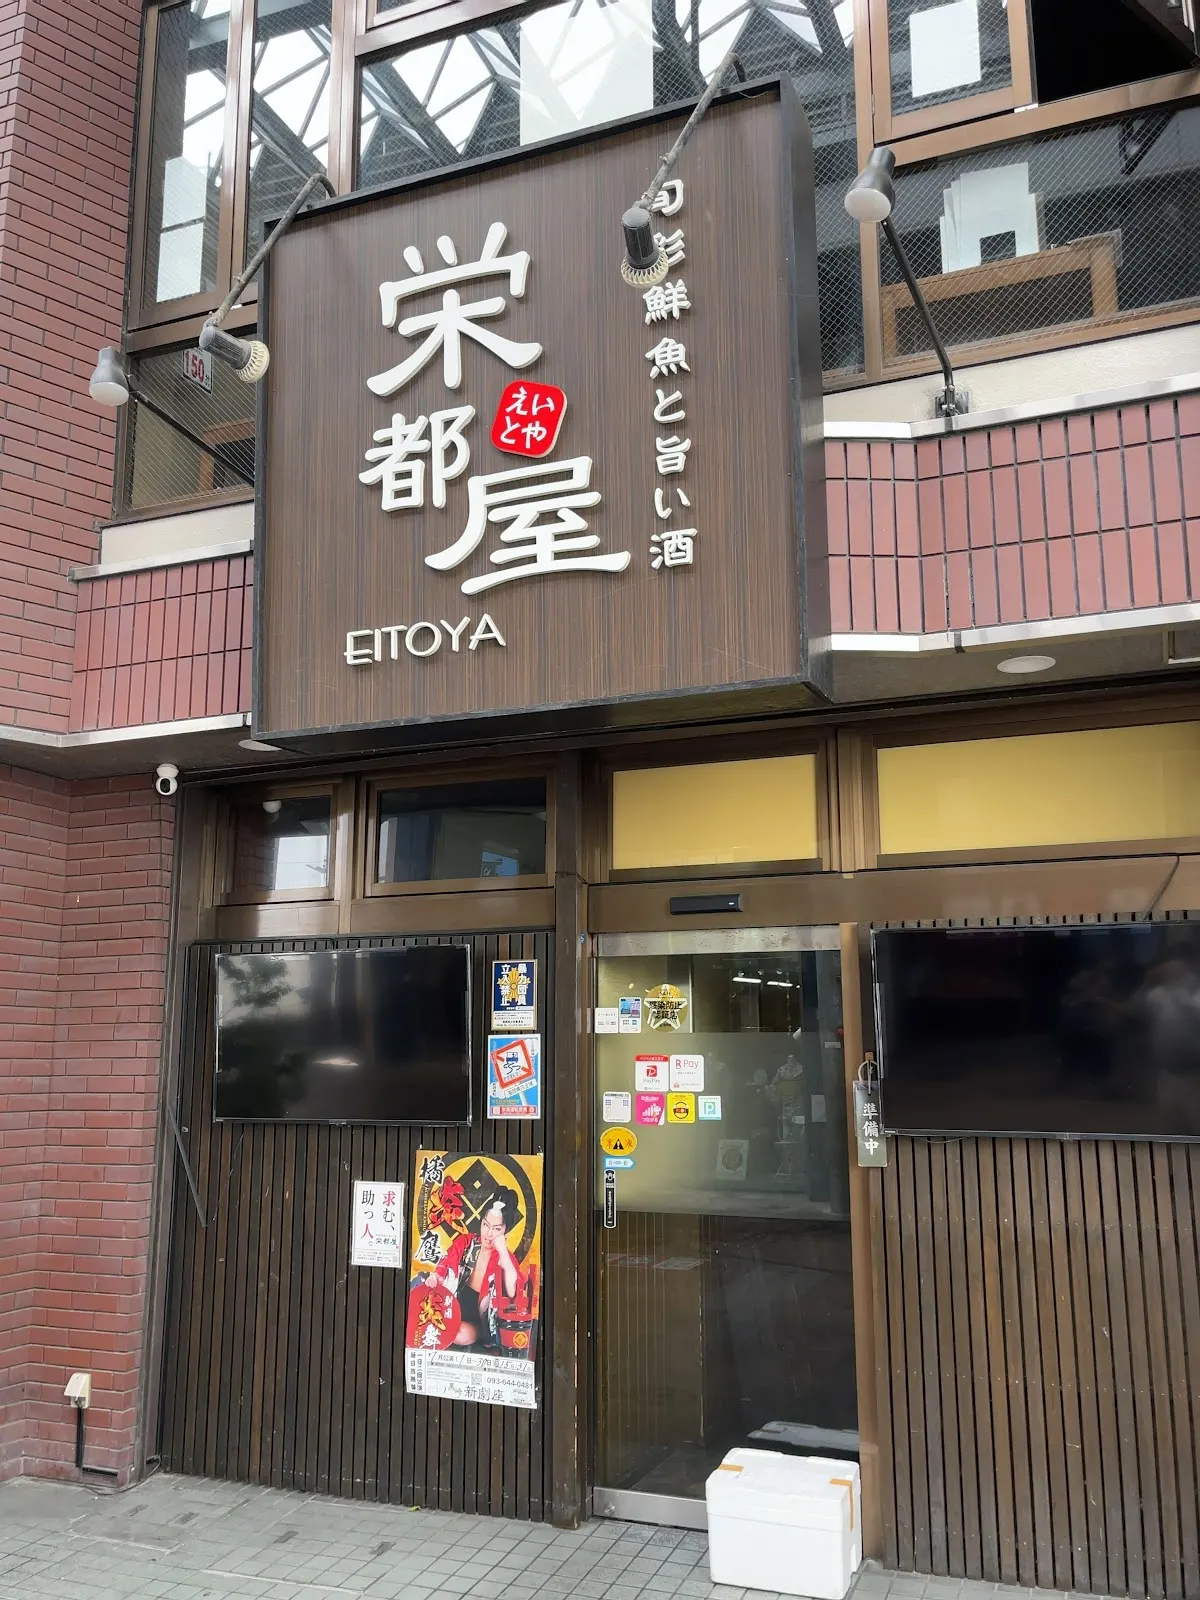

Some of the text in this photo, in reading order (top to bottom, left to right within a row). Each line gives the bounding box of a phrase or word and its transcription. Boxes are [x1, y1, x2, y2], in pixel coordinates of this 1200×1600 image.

[359, 221, 631, 596] 栄都屋
[504, 386, 555, 417] えい
[500, 416, 547, 449] とや
[344, 613, 506, 666] EITOYA
[683, 1059, 699, 1069] Pay
[862, 1102, 879, 1156] 準備中
